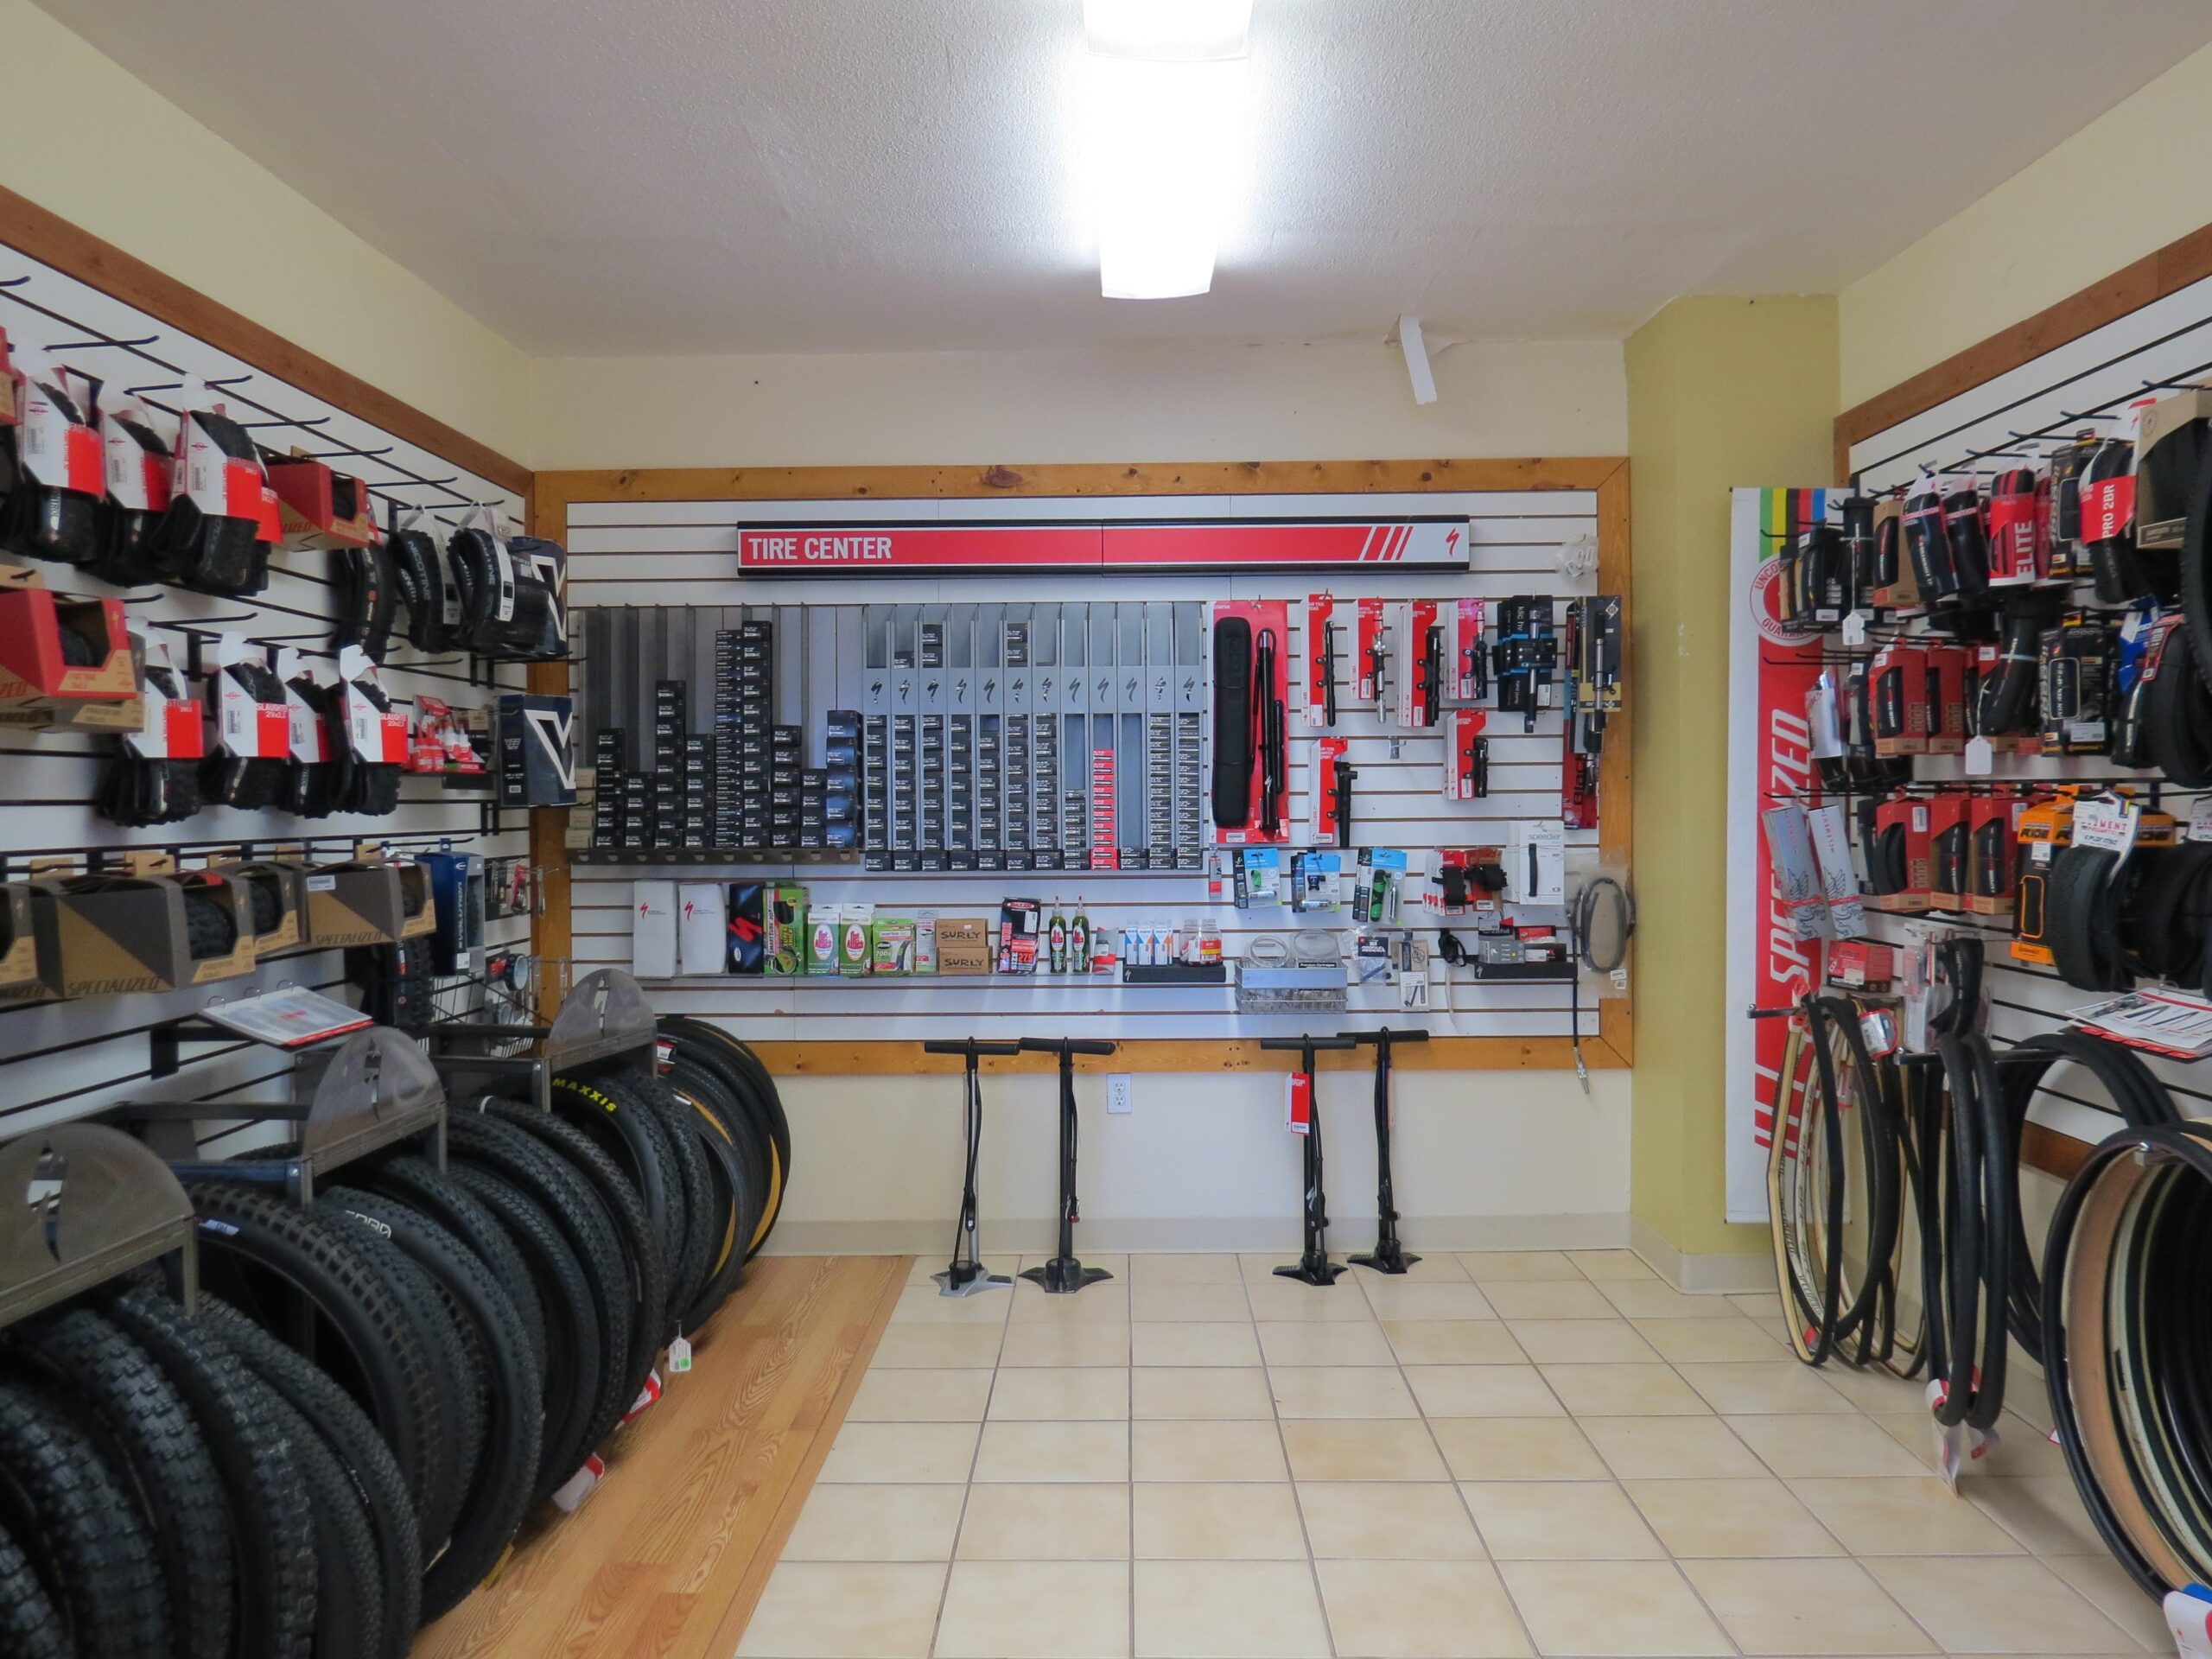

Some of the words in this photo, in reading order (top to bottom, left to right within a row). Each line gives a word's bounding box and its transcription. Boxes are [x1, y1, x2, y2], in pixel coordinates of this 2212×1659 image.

[2102, 484, 2115, 511] 2BR
[2102, 513, 2114, 538] PRO
[748, 537, 798, 560] TIRE
[804, 537, 892, 559] CENTER
[2015, 521, 2032, 575] ELITE
[408, 541, 431, 601] NICOTINE
[941, 931, 981, 939] SURLY
[553, 1077, 617, 1111] MAXXIS
